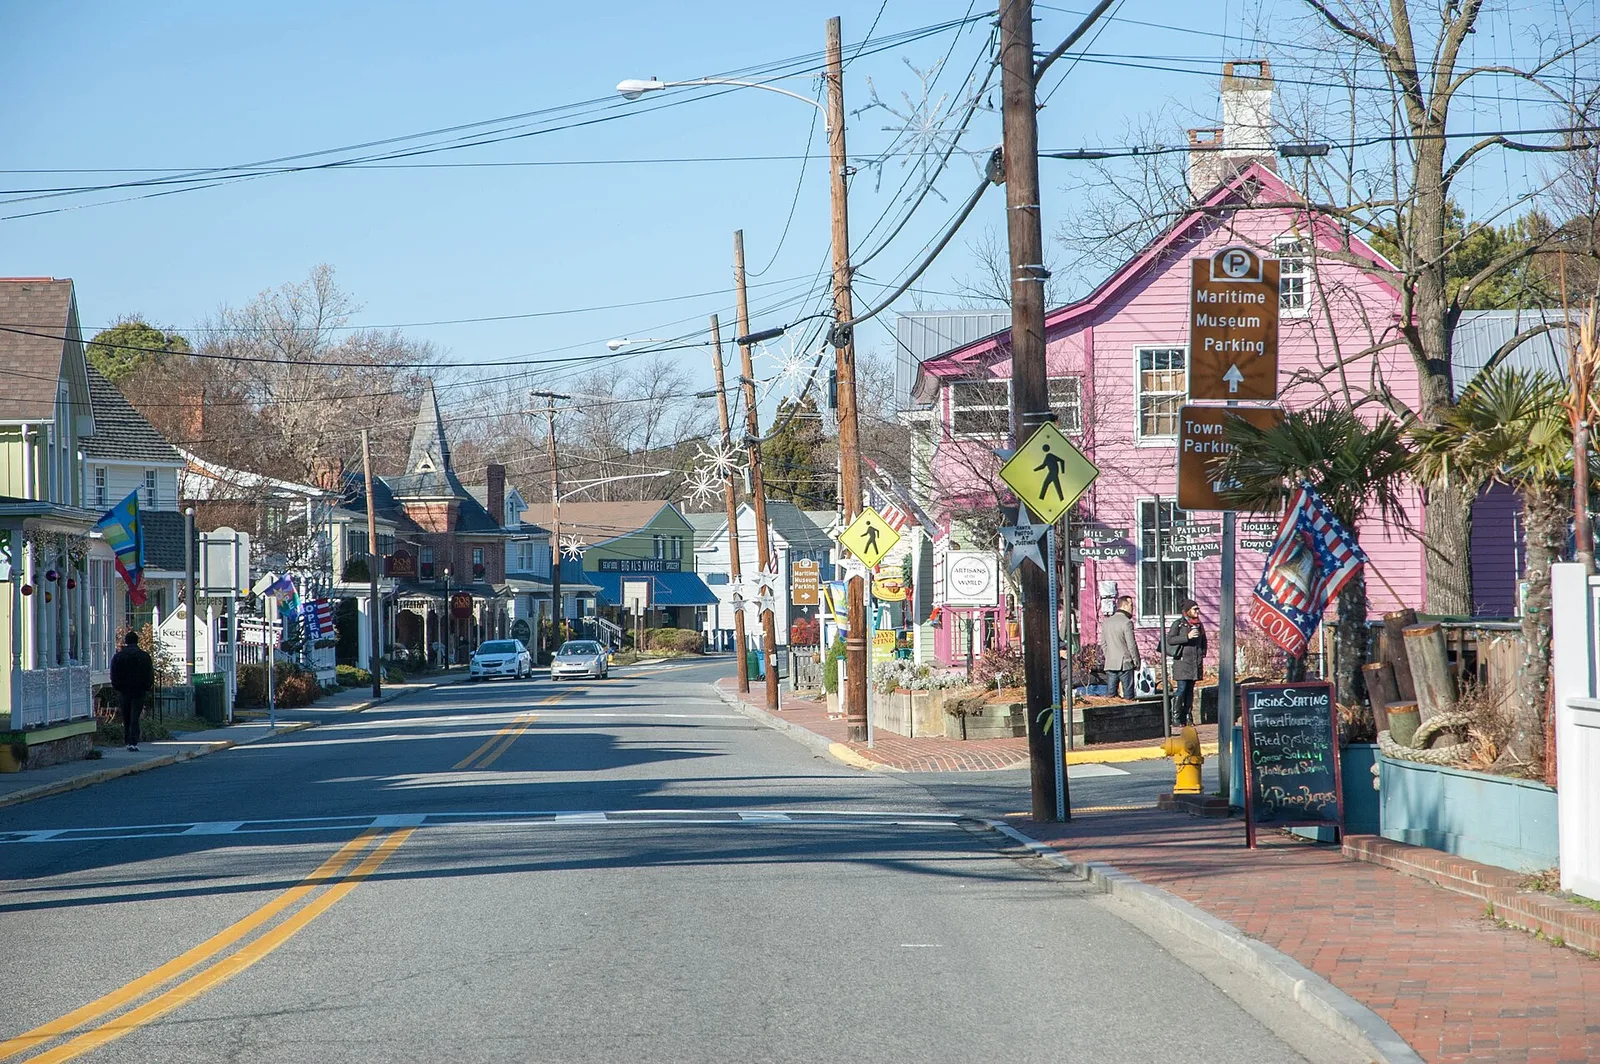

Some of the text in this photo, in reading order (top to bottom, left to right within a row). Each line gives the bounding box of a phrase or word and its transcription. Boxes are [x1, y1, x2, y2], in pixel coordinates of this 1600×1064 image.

[1196, 290, 1266, 304] Maritime
[1196, 314, 1260, 328] Museum
[1204, 338, 1264, 356] Parking
[1185, 420, 1222, 434] Town
[1176, 526, 1211, 534] PATRIOT
[621, 561, 630, 571] BIG
[642, 561, 662, 571] MARKET
[305, 604, 320, 640] OPEN
[1253, 714, 1284, 728] Fried
[1271, 786, 1304, 807] Price
